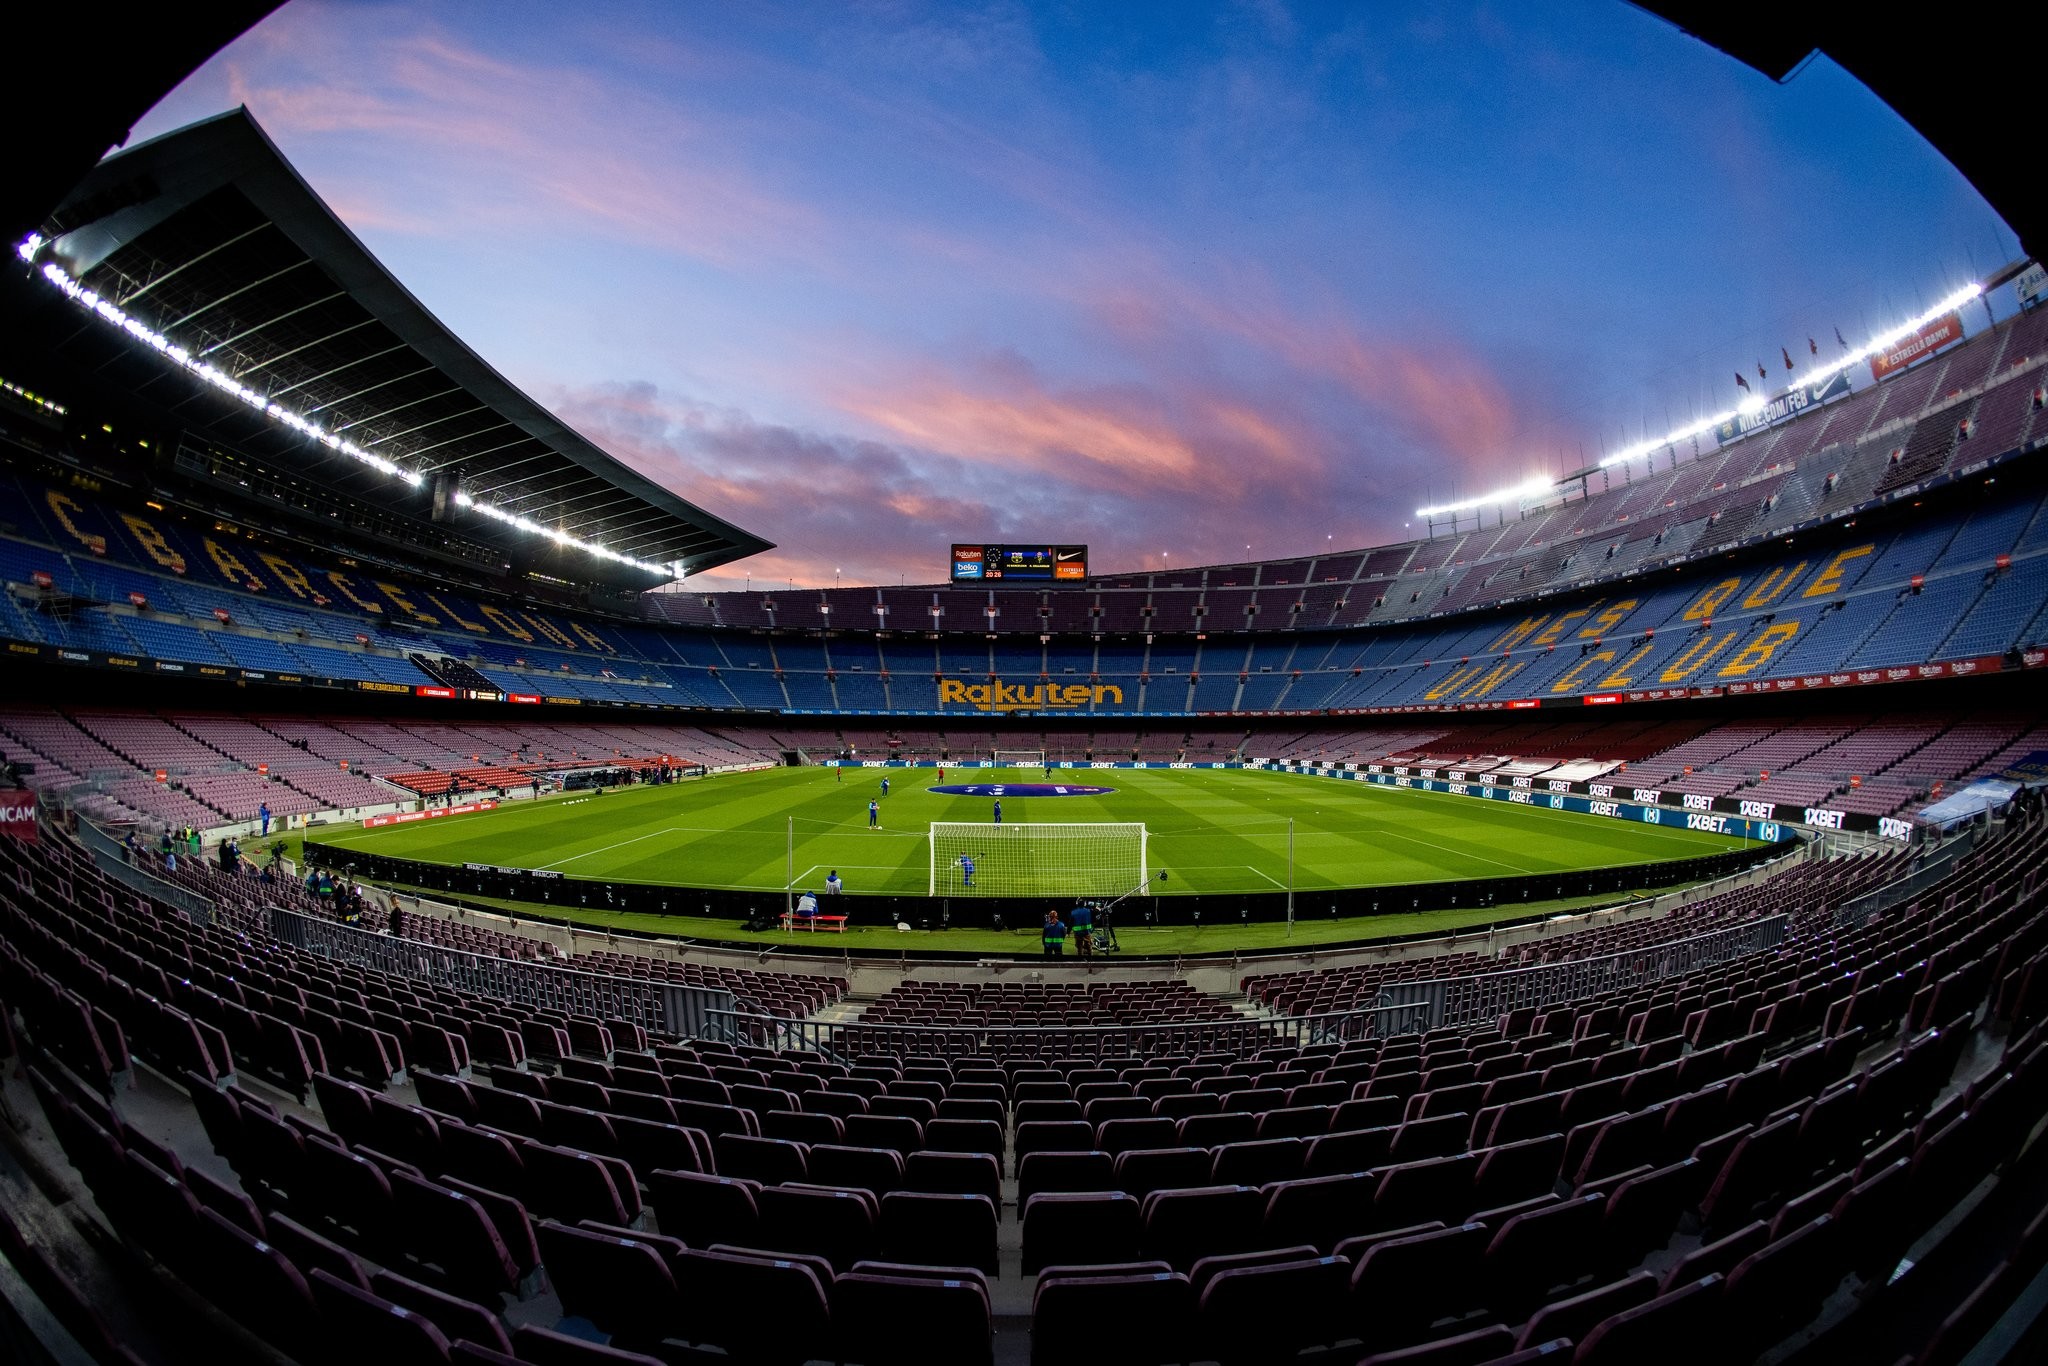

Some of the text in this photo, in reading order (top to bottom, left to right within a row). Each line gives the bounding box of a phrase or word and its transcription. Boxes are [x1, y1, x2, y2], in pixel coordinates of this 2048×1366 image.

[1890, 326, 1950, 365] ESTRELLA DAMM
[1739, 388, 1808, 432] NIKE.COM/FCB
[956, 550, 982, 558] Rakuten
[1683, 544, 1876, 621] QUE
[1424, 620, 1800, 700] UN CLUB
[2023, 652, 2045, 665] Rakuten
[1888, 669, 1910, 680] Rakuten
[1919, 665, 1942, 677] Rakuten
[1952, 662, 1976, 675] Rakuten
[1804, 677, 1823, 688] Rakuten
[1830, 674, 1850, 685] Rakuten
[1858, 672, 1879, 683] Rakuten
[1730, 684, 1747, 693] Rakuten
[1777, 680, 1796, 689] Rakuten
[941, 680, 1123, 704] Rakuten
[1394, 767, 1409, 775] 1XBET
[1420, 769, 1436, 778] 1XBET
[1449, 771, 1466, 781] 1XBET
[1479, 773, 1498, 784] 1XBET
[1513, 777, 1533, 788] 1XBET
[1549, 780, 1572, 793] 1XBET
[1589, 784, 1613, 798] 1XBET
[1509, 791, 1534, 804] 1XBET.es
[1634, 788, 1661, 804] 1XBET
[1683, 794, 1714, 811] 1XBET
[1590, 800, 1622, 818] 1XBET.es
[1740, 800, 1776, 819] 1XBET
[1687, 813, 1732, 835] 1XBET.es
[1805, 808, 1846, 828] 1XBET
[1879, 817, 1913, 842] 1XBET
